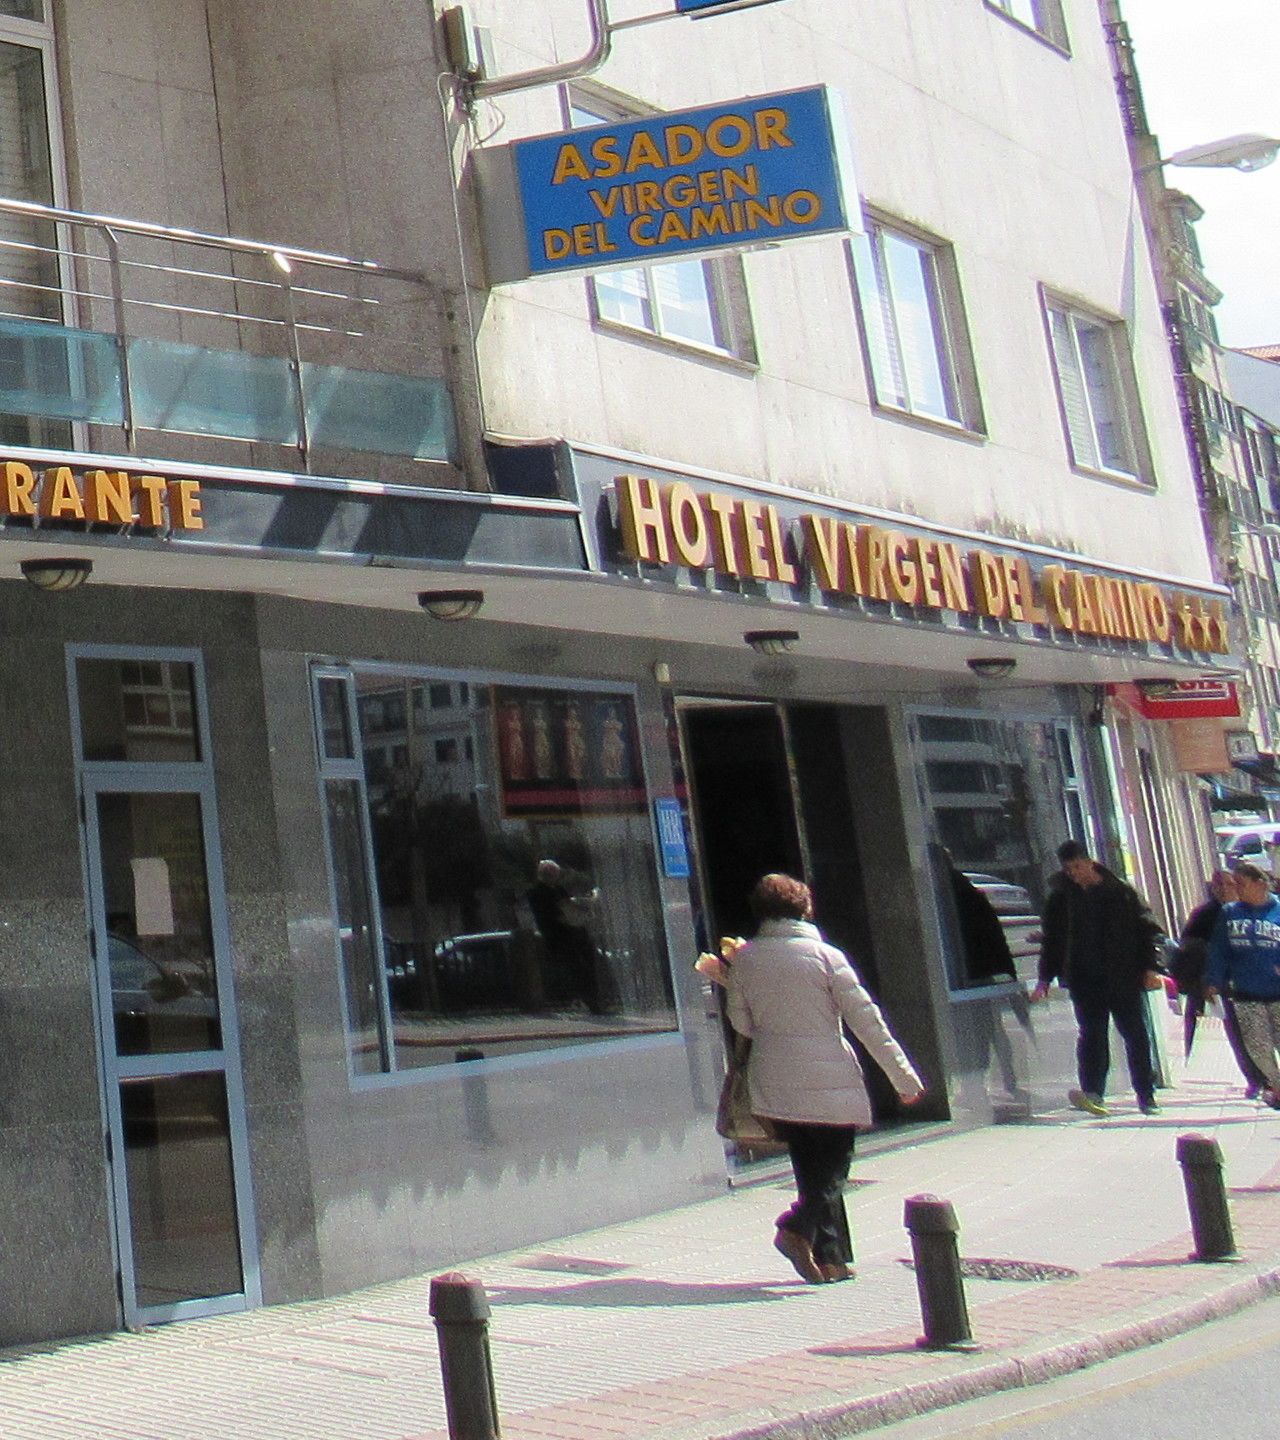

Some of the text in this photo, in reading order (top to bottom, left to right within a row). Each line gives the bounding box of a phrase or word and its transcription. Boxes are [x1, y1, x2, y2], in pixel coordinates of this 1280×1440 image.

[551, 107, 795, 186] ASADOR
[544, 189, 822, 261] DEL CAMINO
[588, 164, 760, 220] VIRGEN
[614, 474, 1172, 643] HOTEL VIRGEN DEL CAMINO
